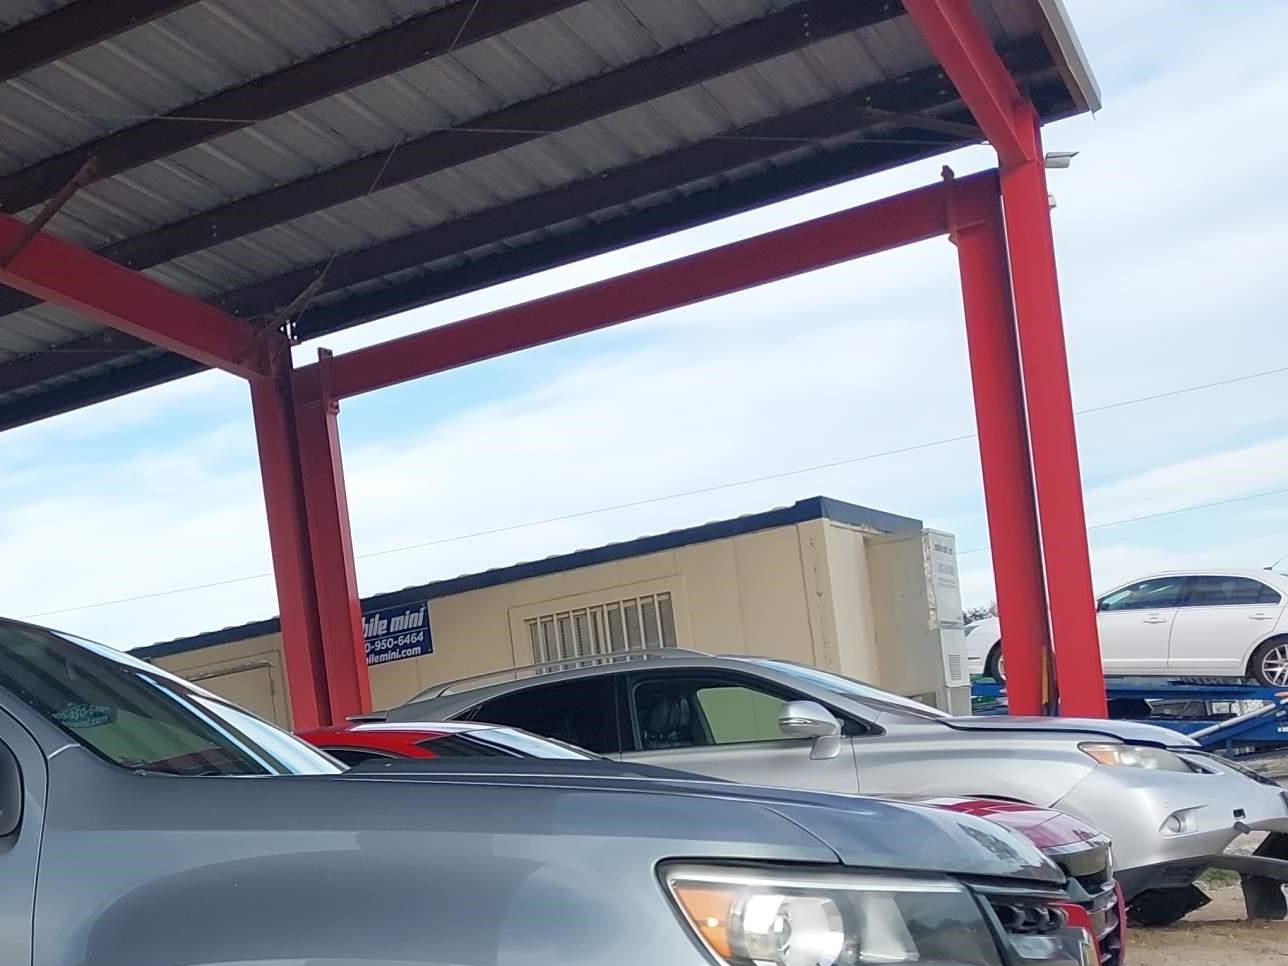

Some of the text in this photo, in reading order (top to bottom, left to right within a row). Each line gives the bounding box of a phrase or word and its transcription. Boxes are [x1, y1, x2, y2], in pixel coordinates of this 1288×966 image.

[390, 607, 425, 632] mini
[364, 631, 424, 653] 0-950-6464
[366, 646, 422, 664] ilemini.com
